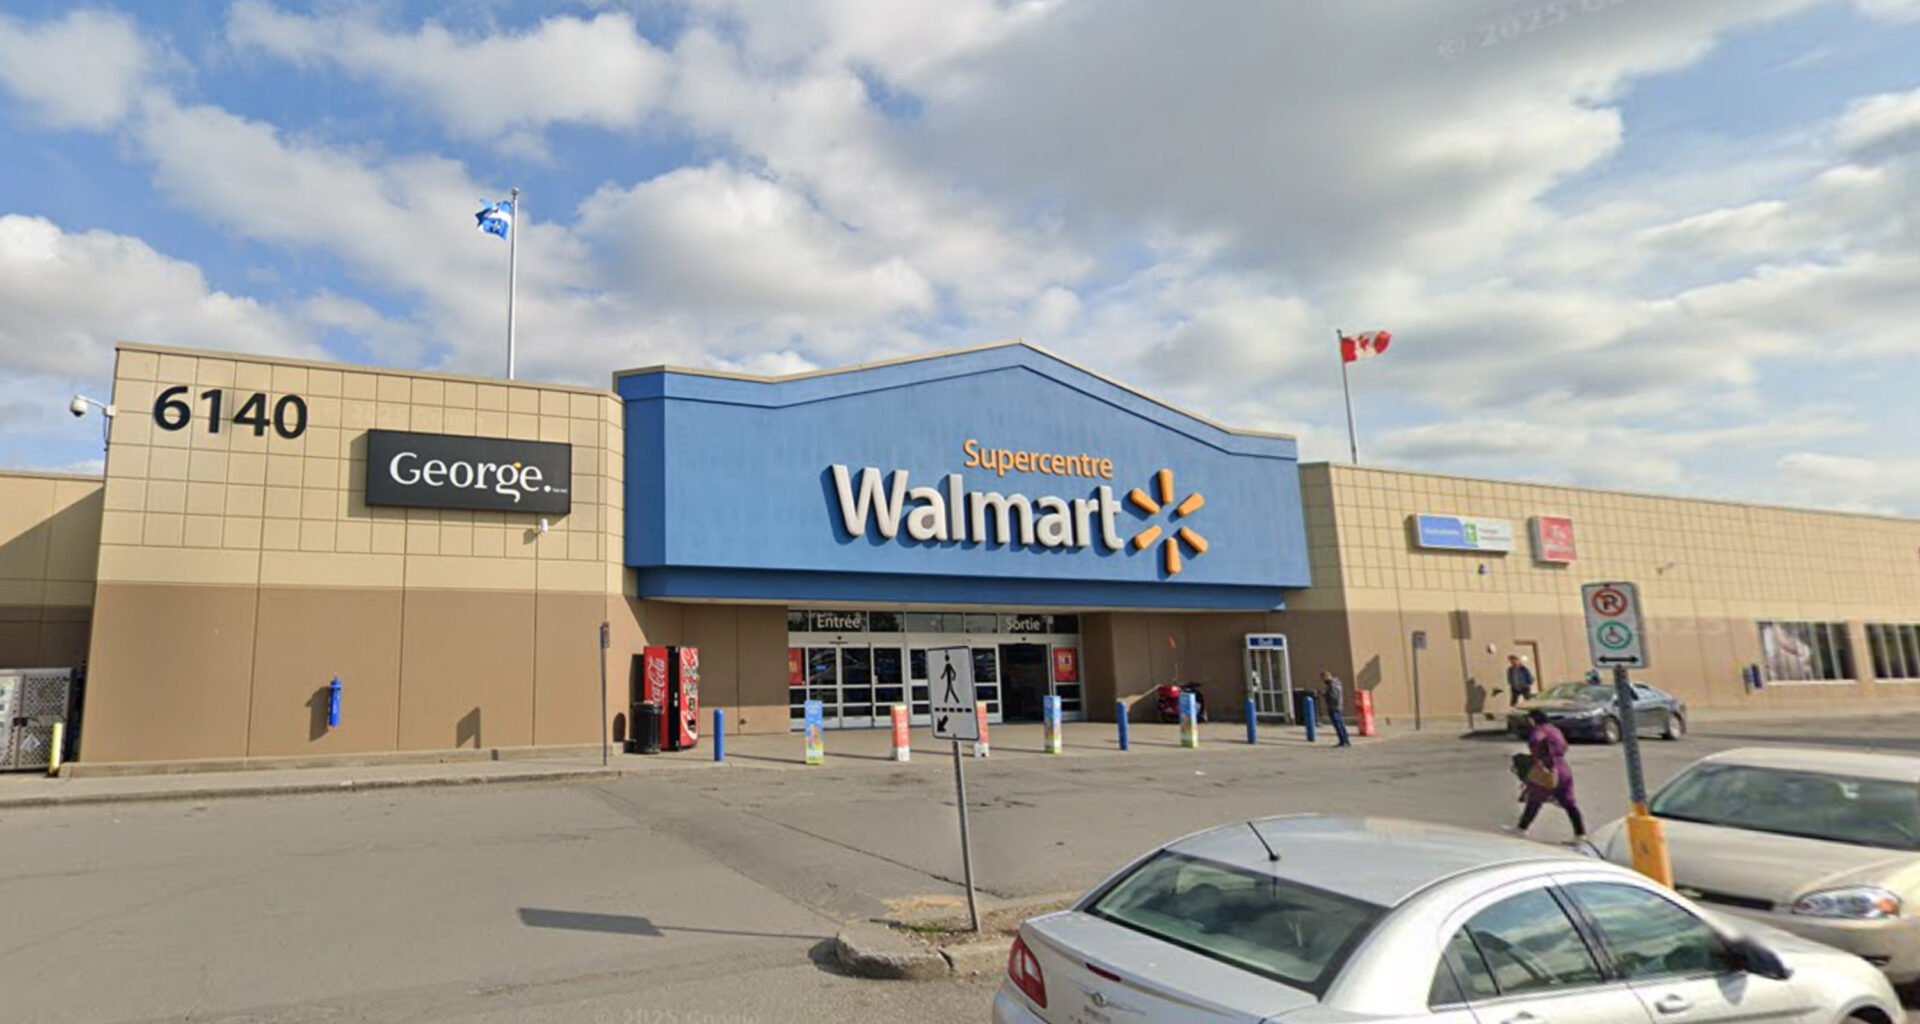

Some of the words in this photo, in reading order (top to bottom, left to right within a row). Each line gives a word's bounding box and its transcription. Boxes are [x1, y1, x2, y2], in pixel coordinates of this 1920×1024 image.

[153, 385, 308, 440] 6140
[389, 451, 551, 504] George.
[963, 439, 1114, 480] Supercentre
[831, 463, 1125, 551] Walmart
[816, 613, 861, 629] Entrée
[1006, 618, 1041, 631] Sortie
